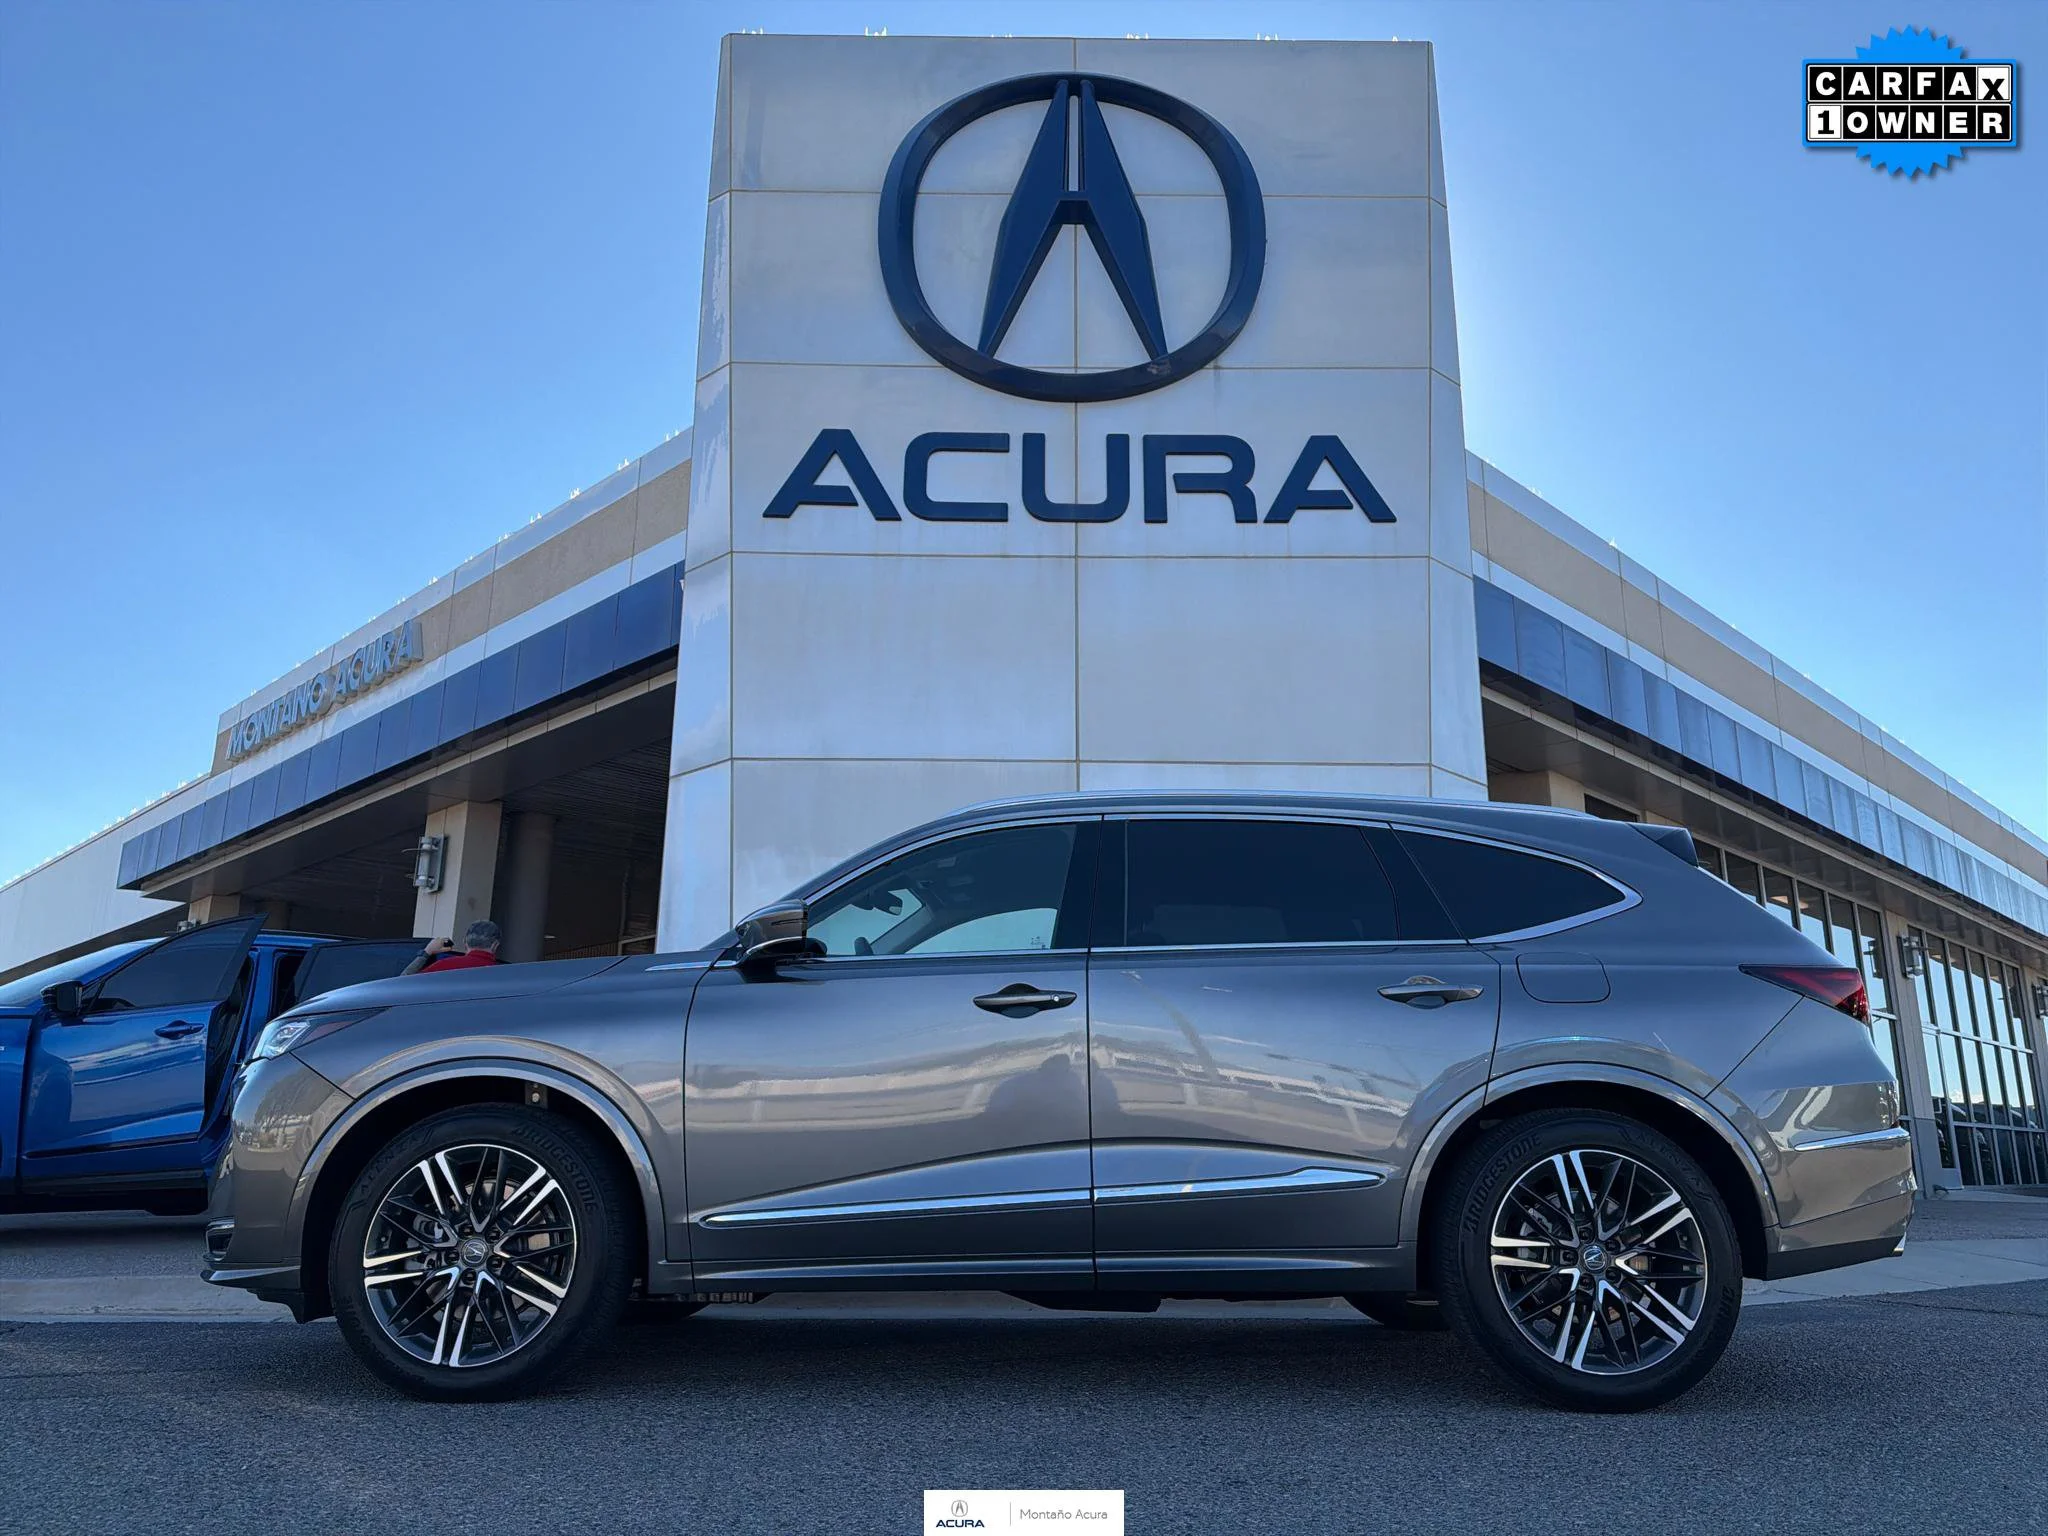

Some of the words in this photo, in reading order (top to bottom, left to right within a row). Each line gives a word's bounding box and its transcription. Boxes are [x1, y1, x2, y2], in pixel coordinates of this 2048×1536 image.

[762, 428, 1398, 523] ACURA
[333, 619, 421, 699] ACURA
[1463, 1133, 1543, 1234] BRIDGESTONE
